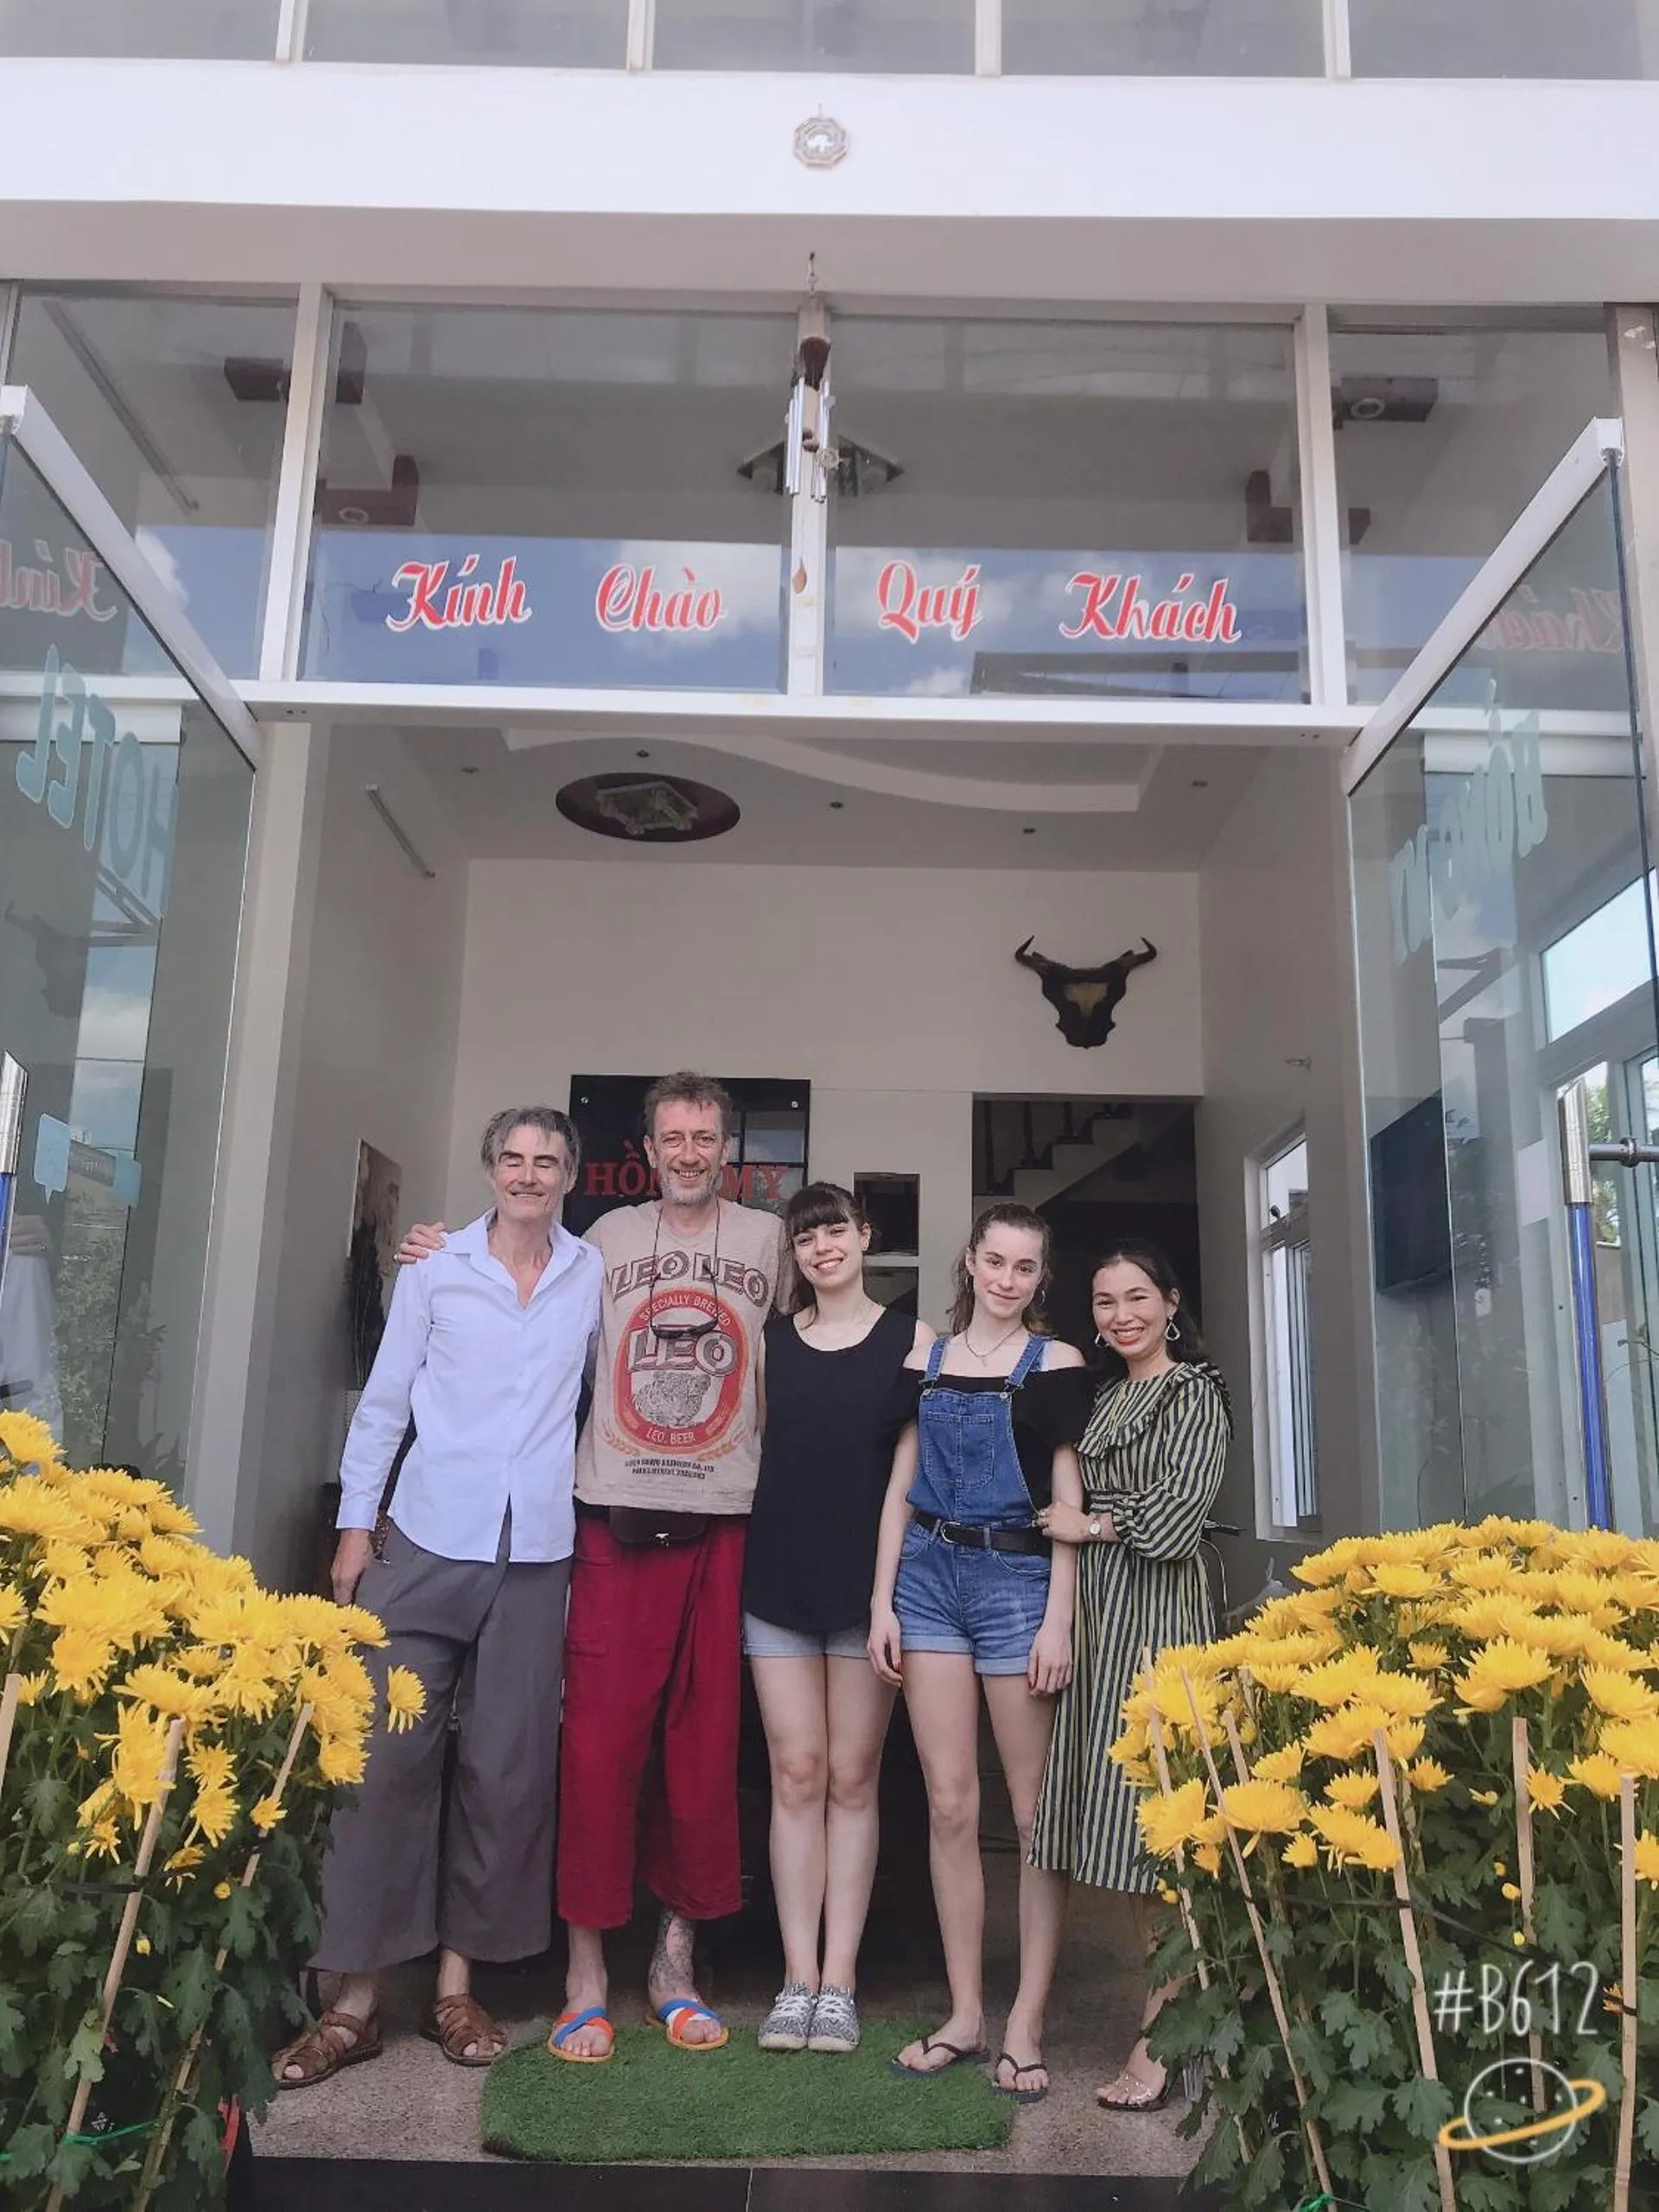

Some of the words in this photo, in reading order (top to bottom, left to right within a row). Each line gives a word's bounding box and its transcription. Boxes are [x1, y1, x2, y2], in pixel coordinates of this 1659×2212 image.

[385, 554, 532, 632] Kính
[595, 563, 728, 632] Chào
[876, 559, 986, 644] Quý
[1058, 570, 1243, 643] Khách
[610, 1249, 690, 1303] LEO
[692, 1252, 769, 1307] LEO
[640, 1294, 690, 1321] SPECIALLY
[627, 1327, 737, 1377] LEO
[670, 1430, 696, 1445] BEER
